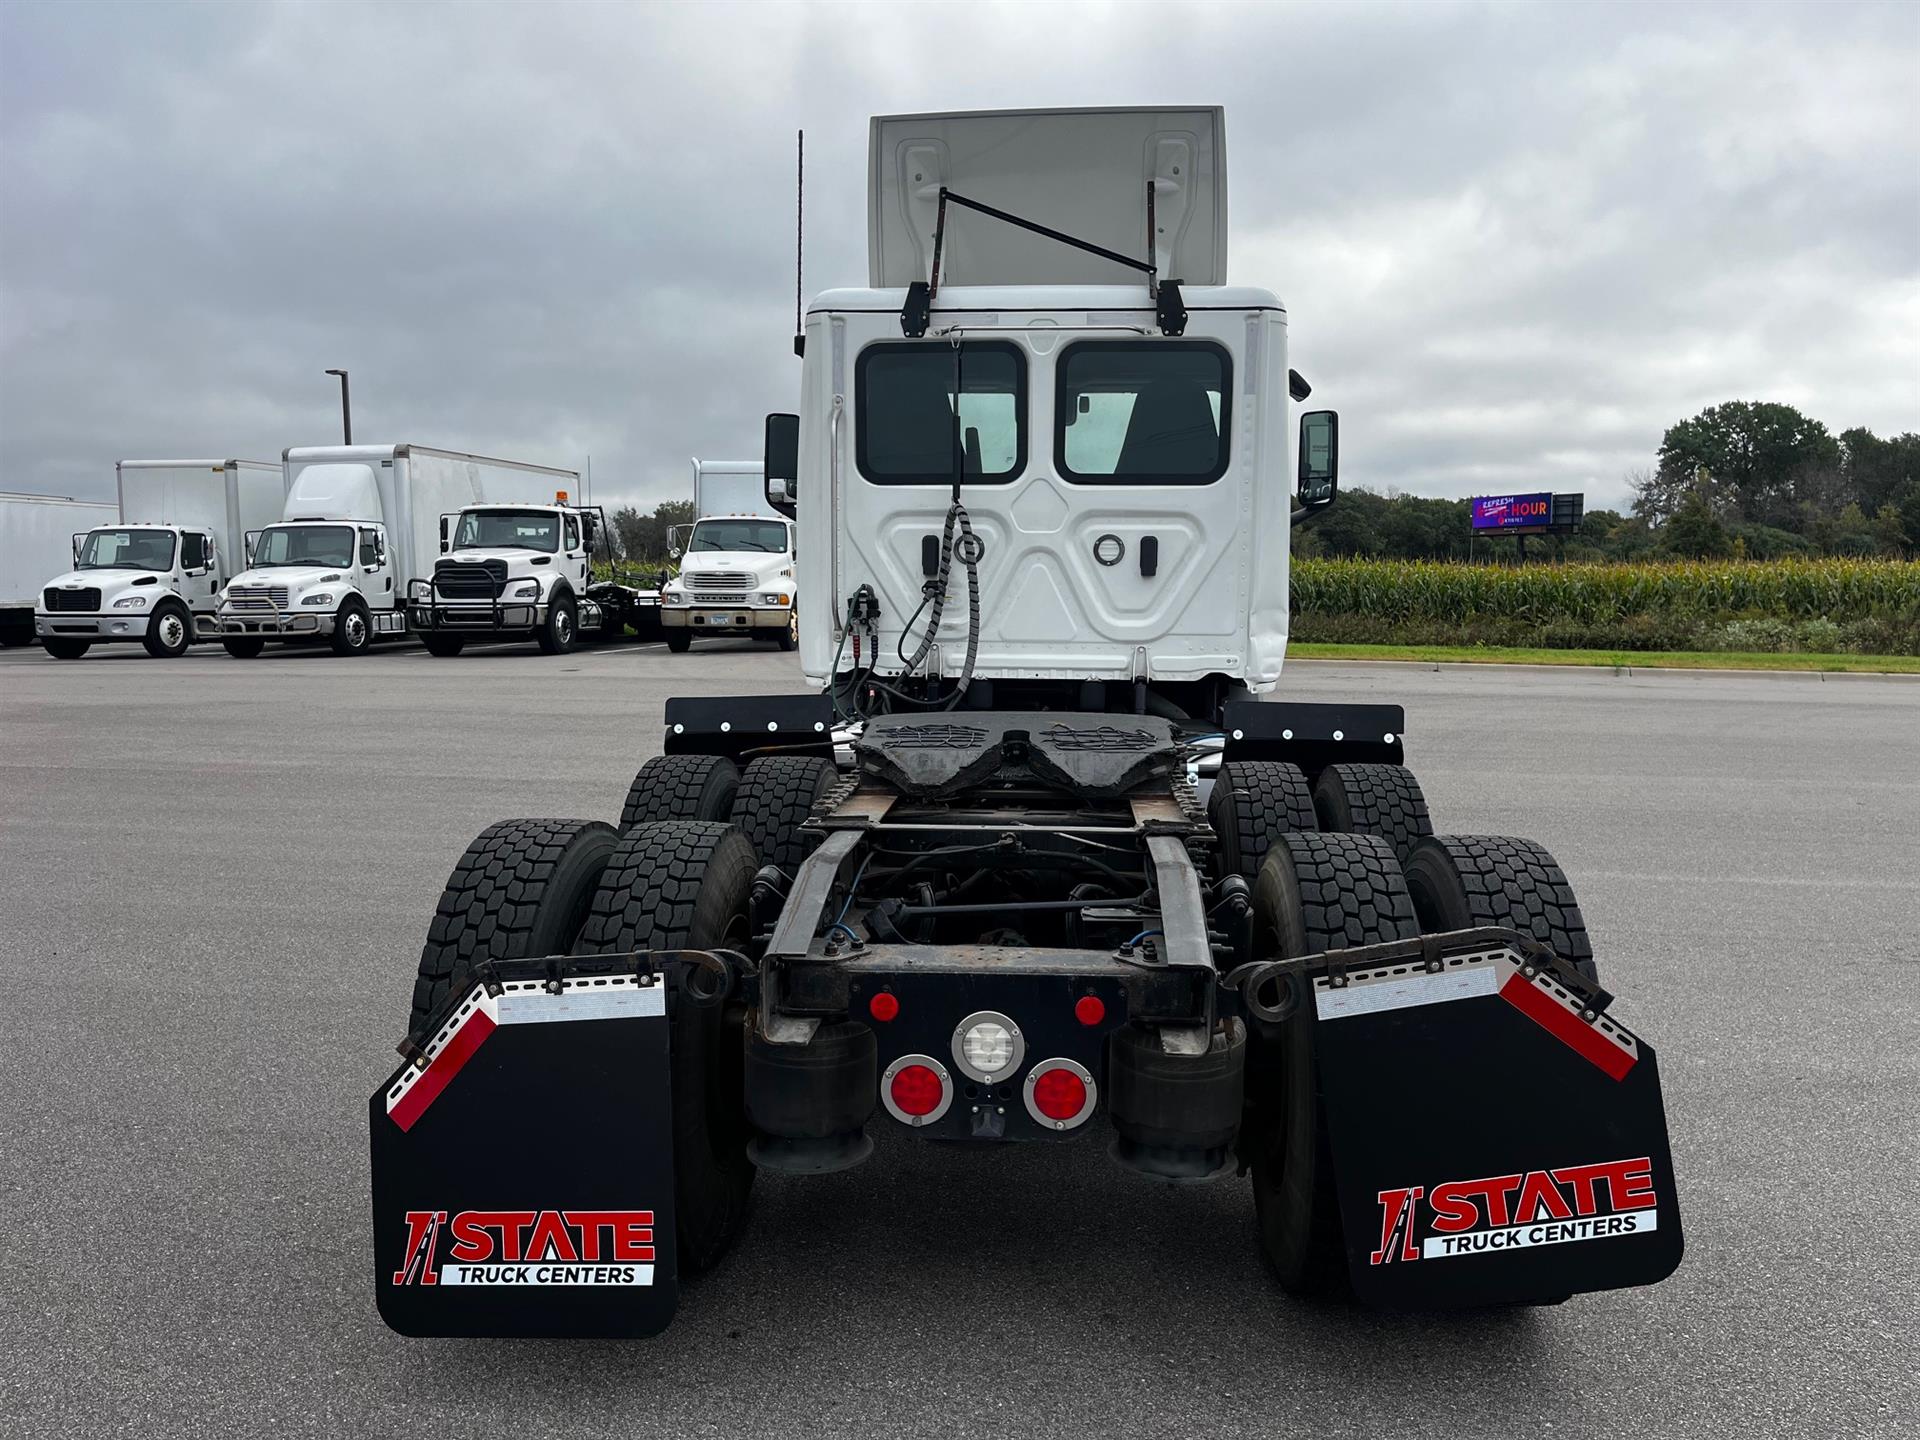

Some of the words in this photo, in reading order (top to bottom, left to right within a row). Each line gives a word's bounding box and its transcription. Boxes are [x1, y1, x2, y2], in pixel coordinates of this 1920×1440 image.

[1483, 497, 1514, 508] REFRESH
[1512, 502, 1547, 516] HOUR
[1430, 1156, 1657, 1232] STATE
[450, 1210, 656, 1262] STATE
[1442, 1230, 1522, 1254] TRUCK
[1528, 1215, 1638, 1244] CENTERS
[459, 1266, 530, 1284] TRUCK
[536, 1266, 635, 1284] CENTERS
